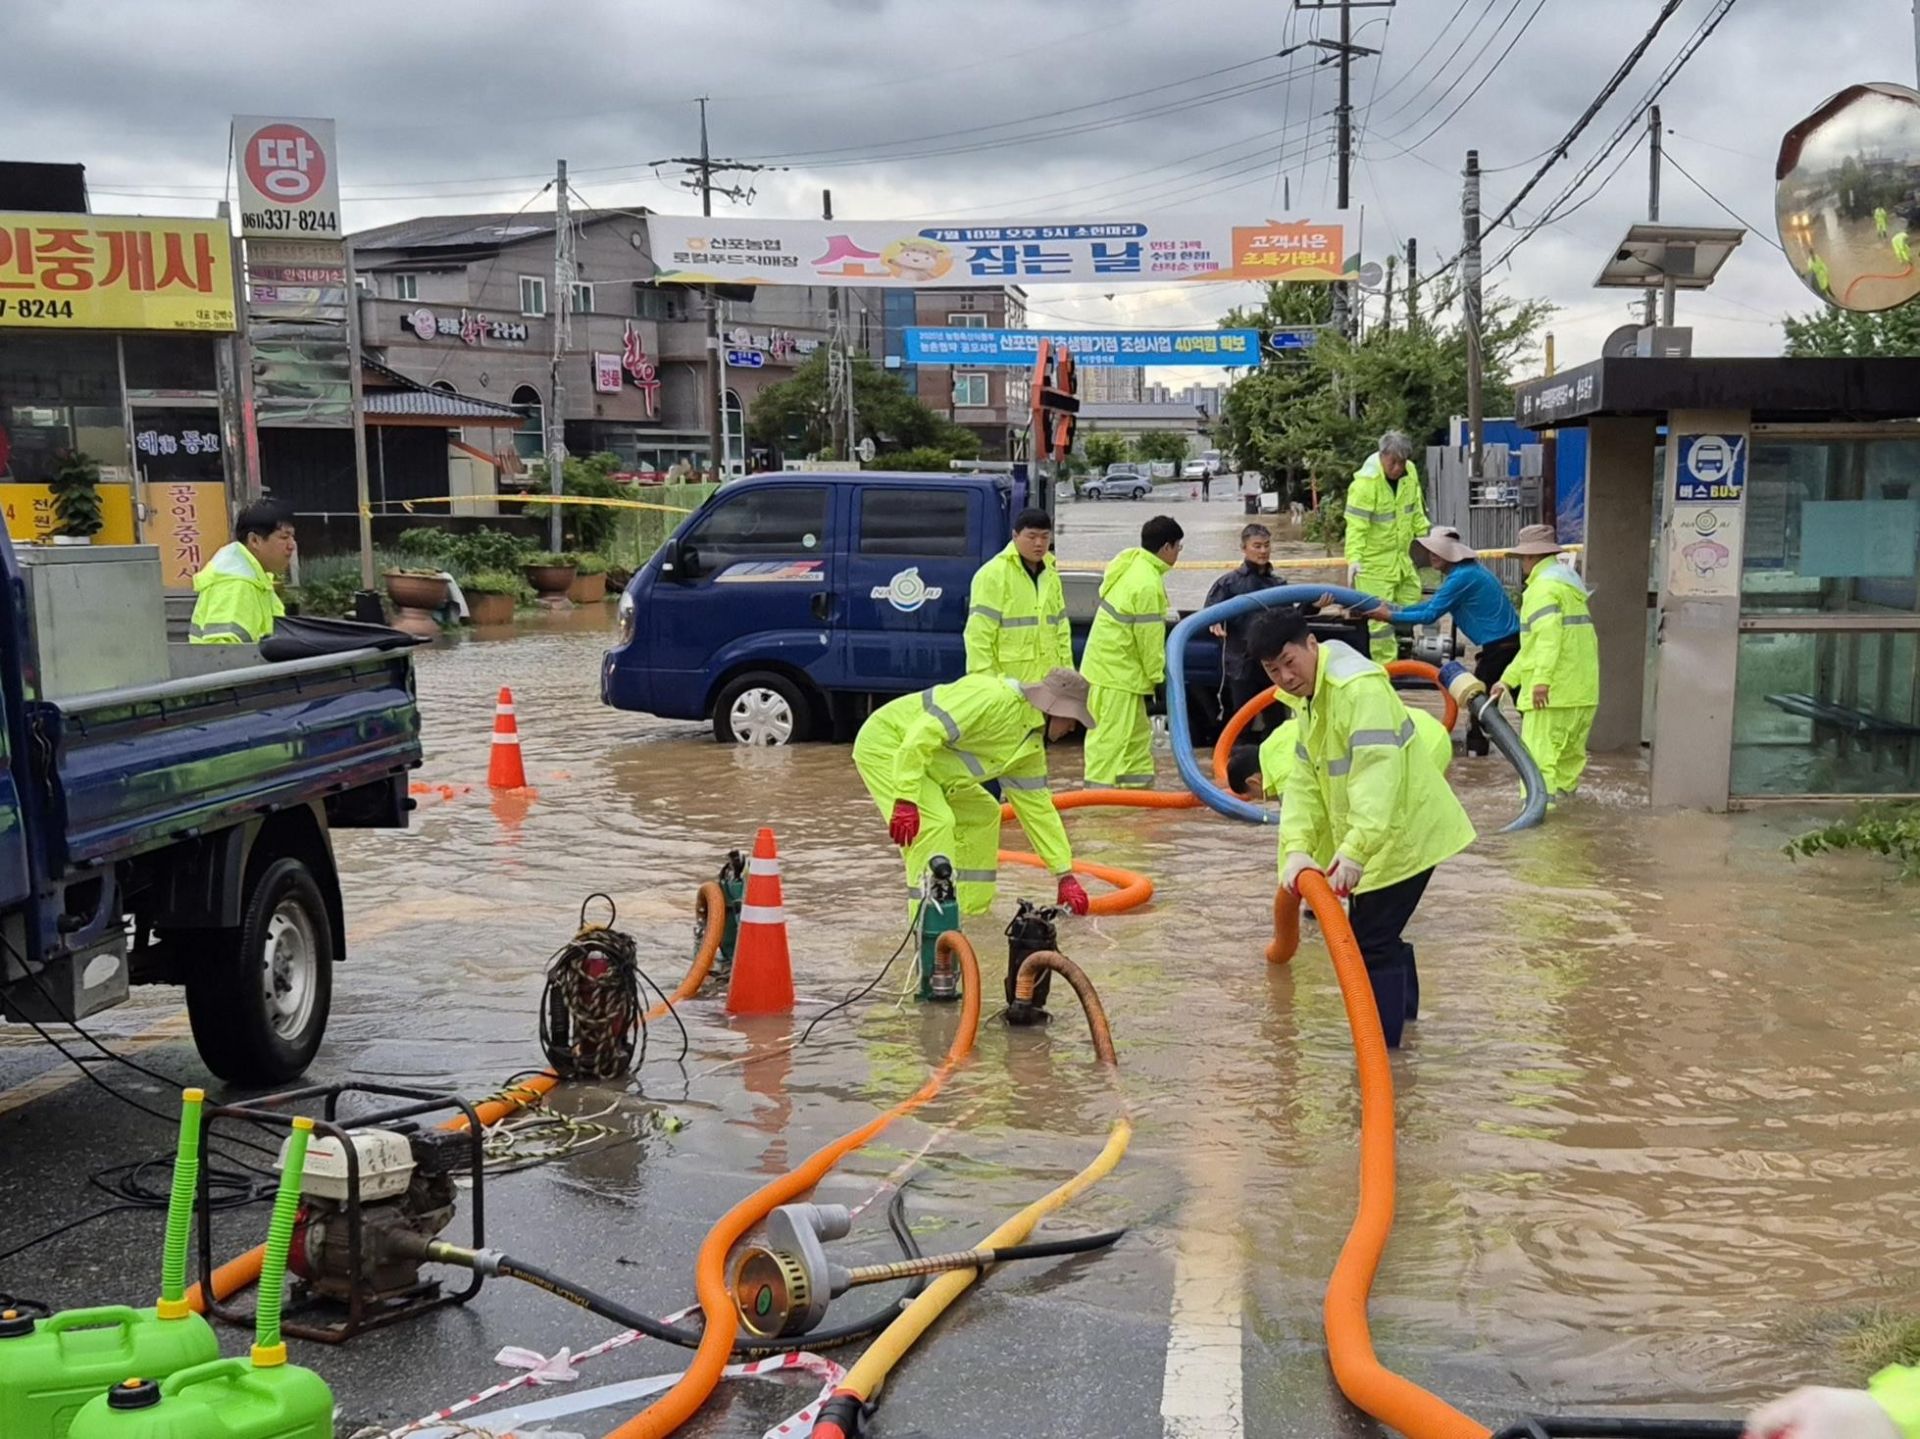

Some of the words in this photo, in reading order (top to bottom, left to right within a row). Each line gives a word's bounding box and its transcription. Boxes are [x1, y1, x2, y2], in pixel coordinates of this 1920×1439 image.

[258, 136, 315, 196] 땅
[242, 209, 337, 232] 061)337-8244
[934, 230, 960, 240] 7월
[965, 229, 1001, 240] 18일
[1006, 228, 1037, 239] 오후
[1042, 227, 1069, 237] 5시
[1249, 234, 1328, 249] 고객사은
[710, 238, 781, 250] 산포농협
[0, 226, 216, 293] 인중개사
[673, 252, 799, 267] 로컬푸드직매장
[966, 243, 1073, 275] 잡는
[1091, 242, 1143, 273] 날
[1241, 251, 1336, 266] 초특가행사
[1000, 335, 1038, 351] 산포면
[1042, 335, 1118, 353] 초생활거점
[1121, 335, 1172, 353] 조성사업
[1175, 336, 1217, 352] 40억원
[1220, 335, 1246, 352] 확보
[1679, 485, 1708, 498] 버스
[1710, 485, 1740, 498] BUS
[168, 485, 200, 578] 공인중개사
